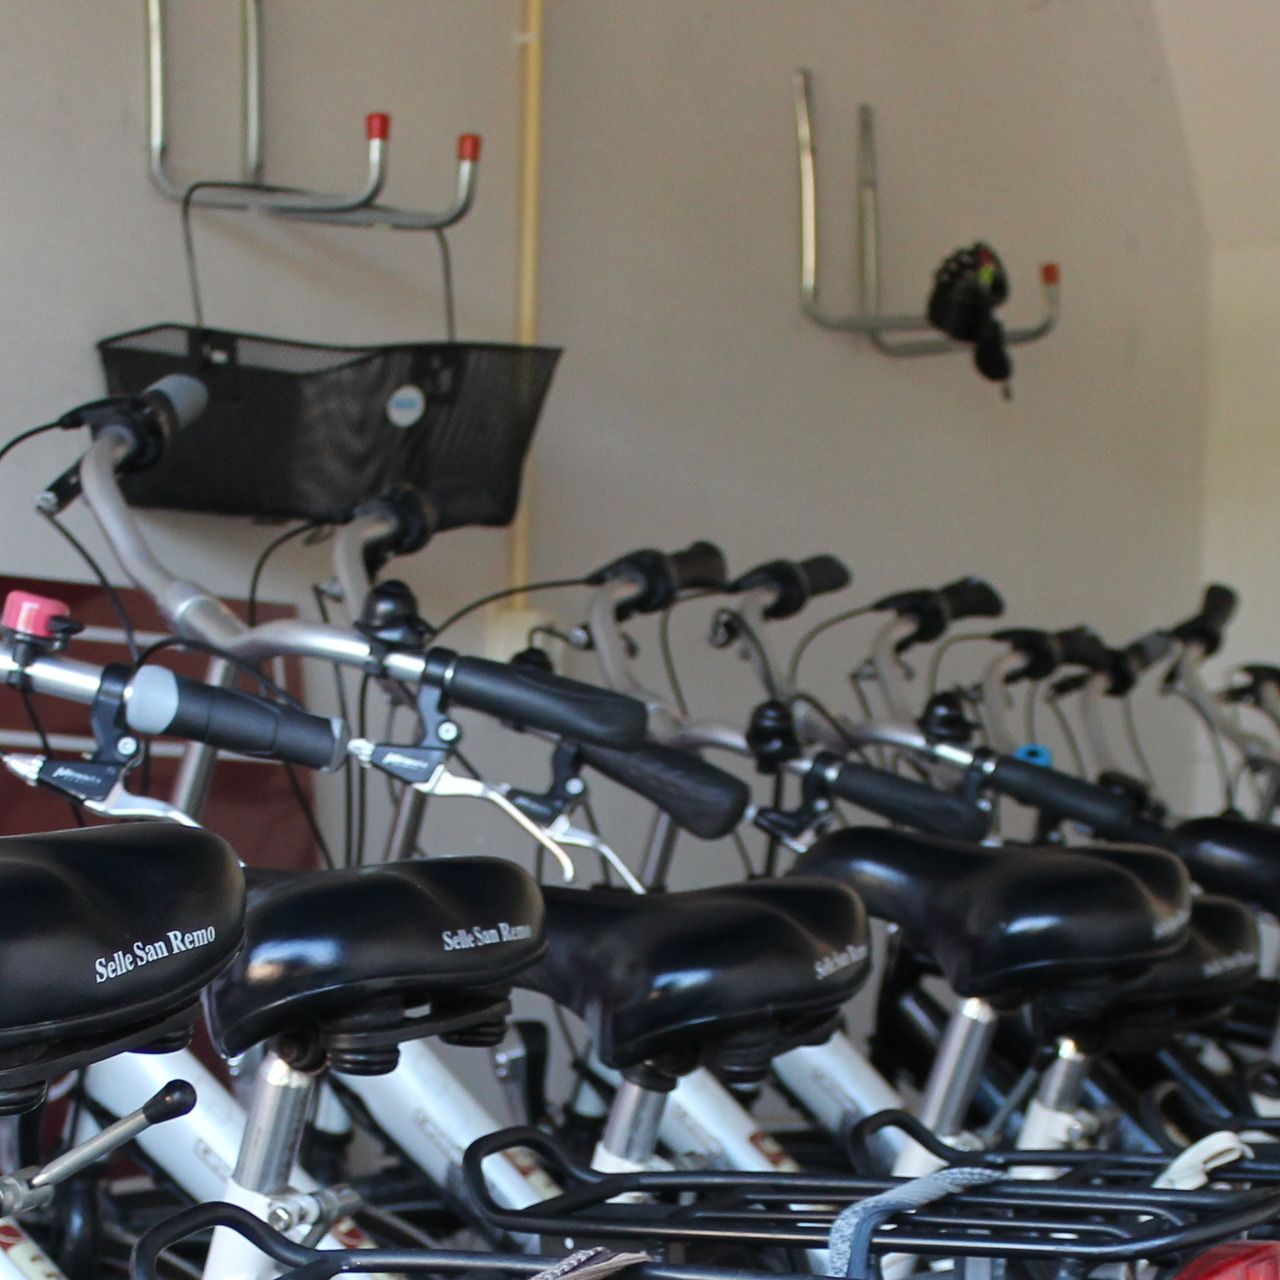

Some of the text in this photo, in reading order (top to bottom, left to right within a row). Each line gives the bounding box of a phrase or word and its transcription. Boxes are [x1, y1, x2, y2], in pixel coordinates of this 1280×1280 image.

[95, 925, 216, 983] Selle San Remo
[442, 929, 475, 951] Selle
[472, 926, 500, 946] San
